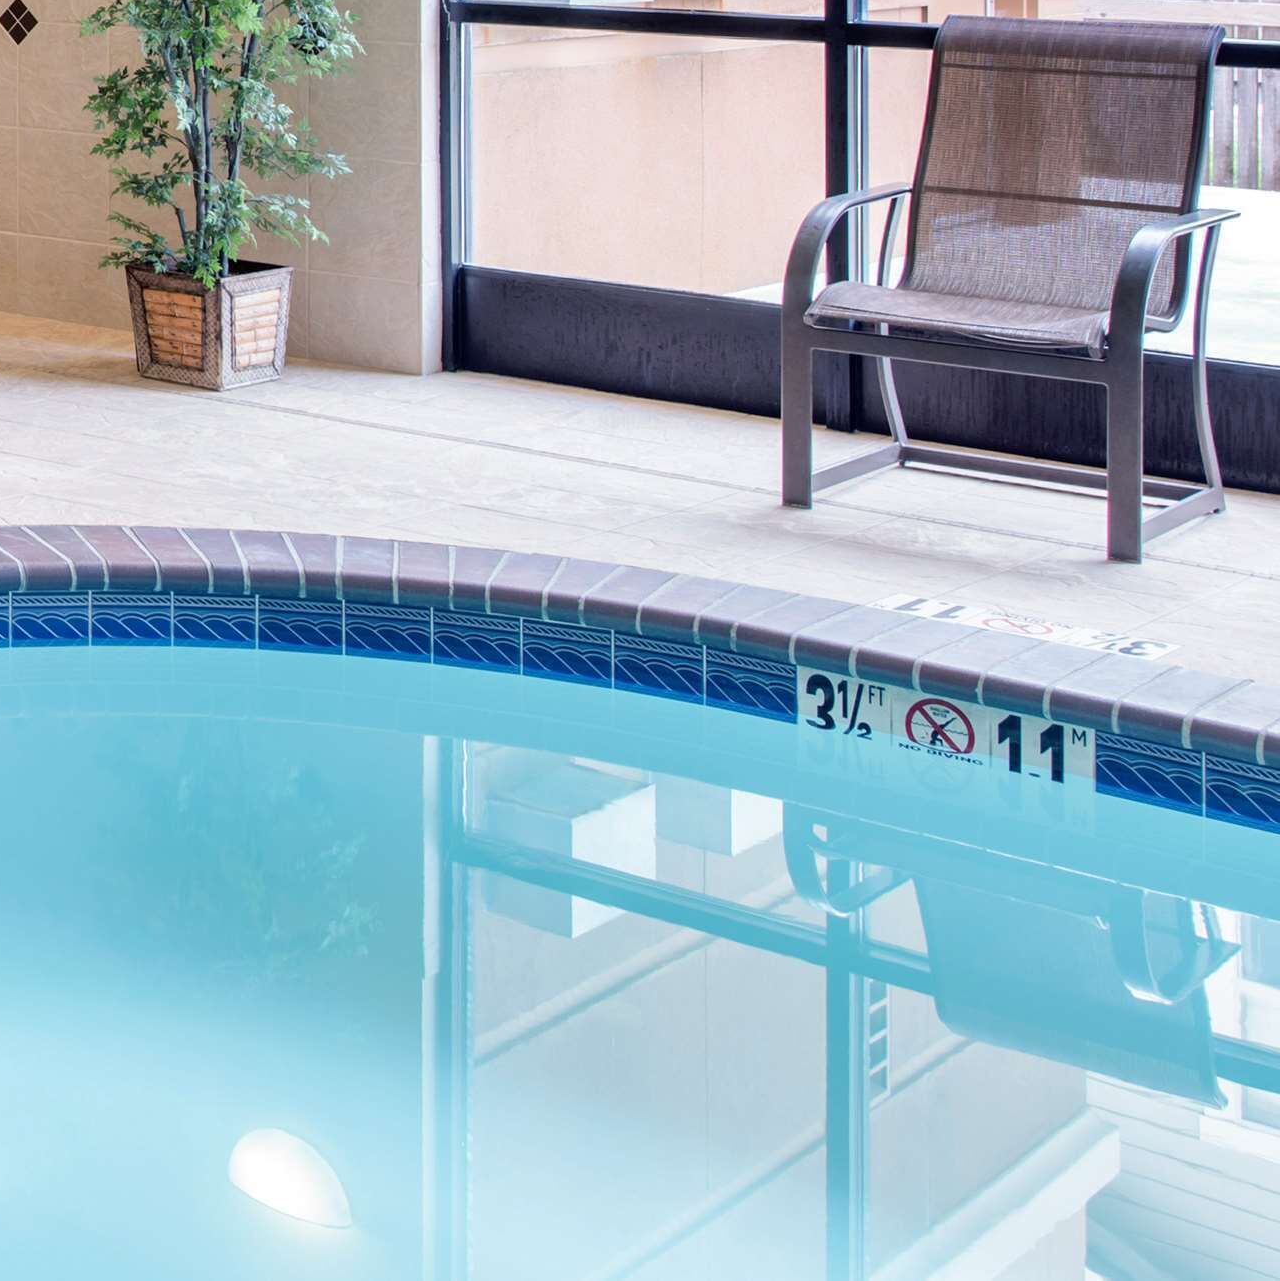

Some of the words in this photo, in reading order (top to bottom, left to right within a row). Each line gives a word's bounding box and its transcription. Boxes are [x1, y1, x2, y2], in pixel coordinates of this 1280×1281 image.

[868, 684, 886, 707] FT
[898, 741, 922, 752] NO
[927, 748, 984, 766] DIVING
[997, 713, 1065, 784] 1.1
[1071, 727, 1088, 748] M
